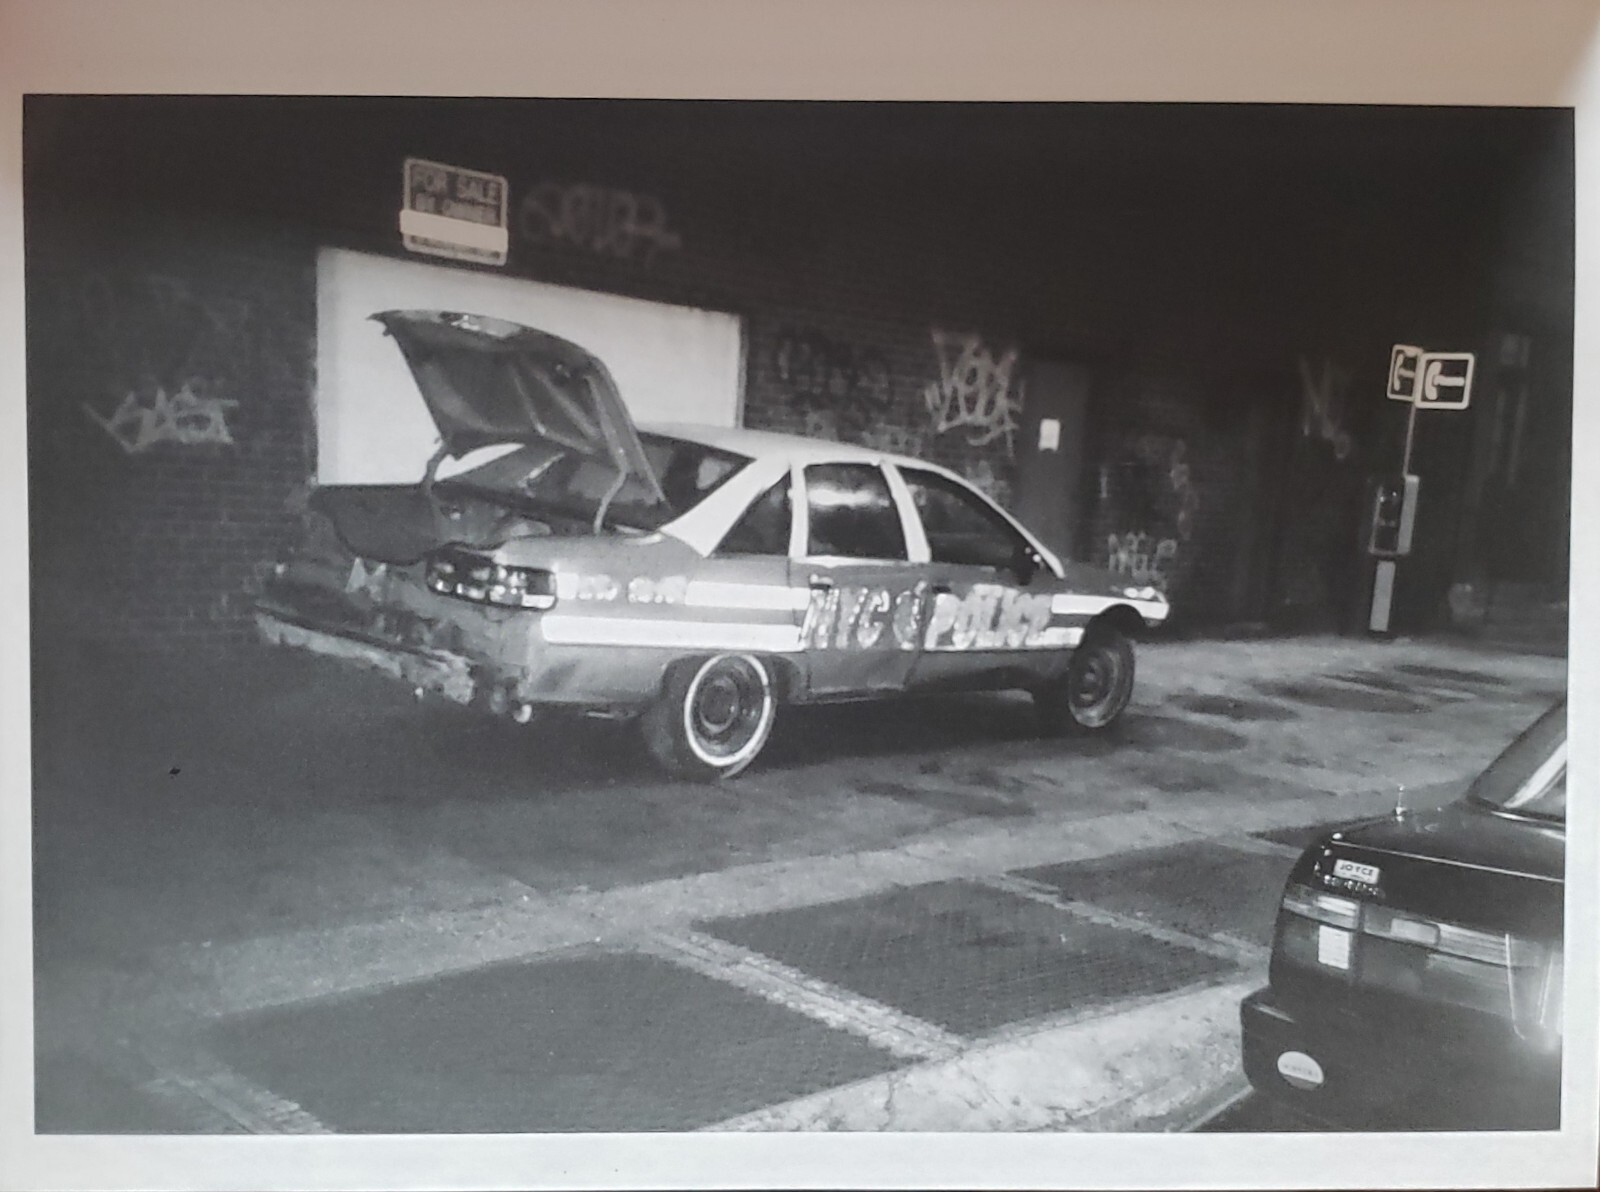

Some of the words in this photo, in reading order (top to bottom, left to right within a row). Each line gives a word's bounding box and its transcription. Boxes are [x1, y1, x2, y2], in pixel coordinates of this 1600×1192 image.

[411, 165, 447, 194] FOR
[457, 175, 500, 205] SALE
[924, 584, 1051, 650] POLICE
